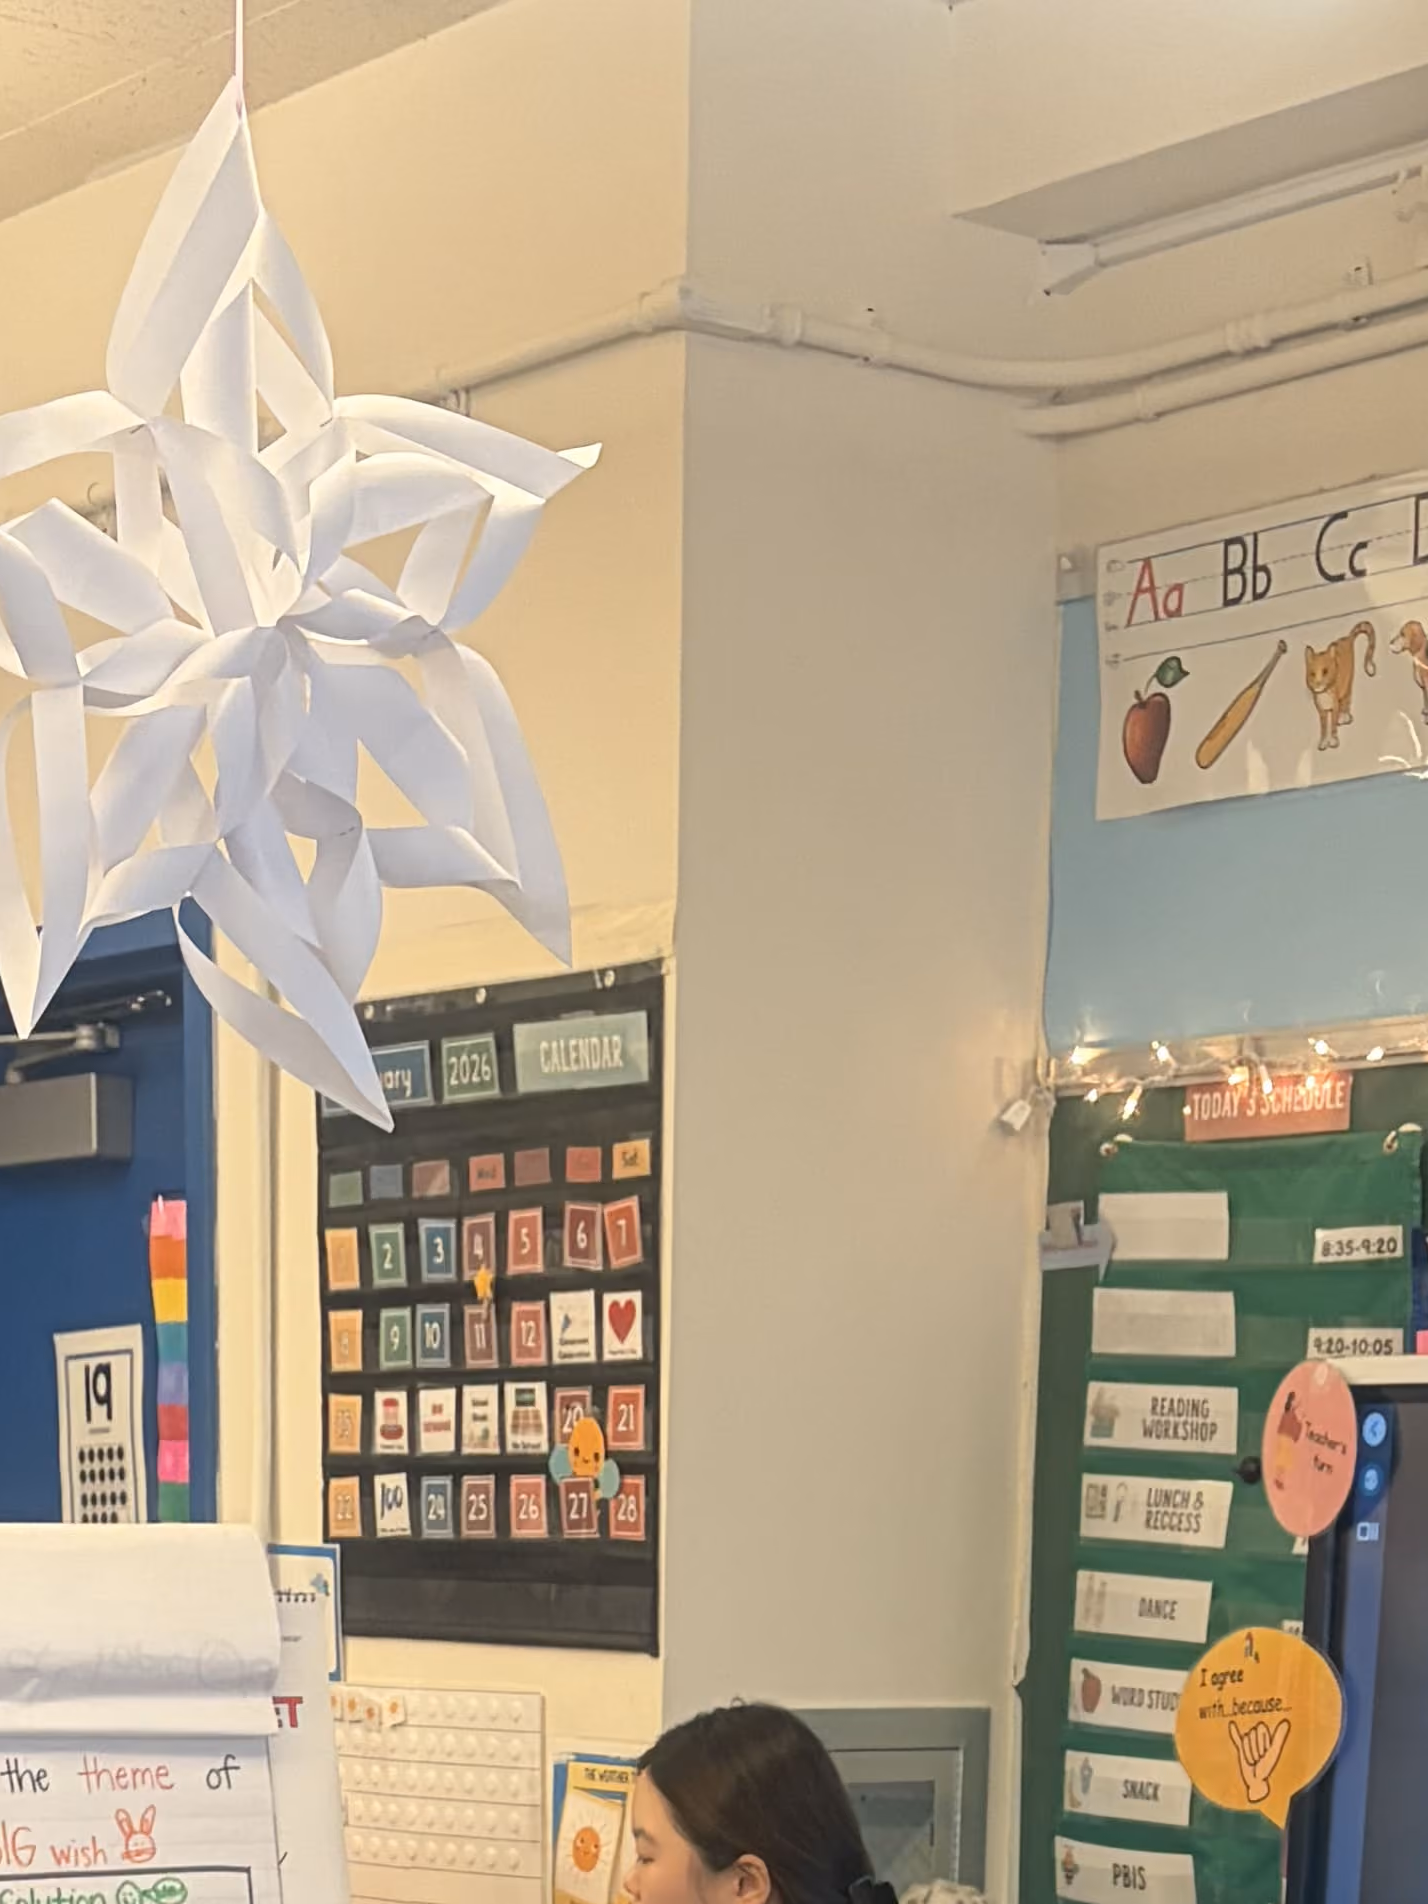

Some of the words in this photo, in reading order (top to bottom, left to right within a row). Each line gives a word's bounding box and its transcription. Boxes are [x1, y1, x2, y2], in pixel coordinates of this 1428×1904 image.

[1127, 557, 1185, 628] Aa
[1221, 534, 1274, 608] Bb
[1314, 509, 1368, 584] Cc
[449, 1054, 491, 1085] 2026
[539, 1035, 623, 1072] CALENDAR
[382, 1244, 392, 1269] 2
[433, 1238, 444, 1264] 3
[474, 1234, 484, 1259] 4
[522, 1229, 530, 1253] 5
[577, 1221, 586, 1248] 6
[617, 1220, 626, 1246] 7
[1322, 1238, 1397, 1256] 8:35-9:20
[390, 1326, 399, 1350] 9
[425, 1323, 441, 1348] 10
[475, 1324, 486, 1347] 11
[522, 1321, 536, 1346] 12
[83, 1361, 113, 1424] 19
[618, 1404, 635, 1431] 21
[1151, 1396, 1210, 1419] READING
[1142, 1419, 1217, 1441] WORKSHOP
[428, 1495, 445, 1519] 24
[469, 1494, 487, 1520] 25
[519, 1494, 539, 1518] 26
[569, 1494, 588, 1519] 27
[617, 1495, 637, 1521] 28
[1146, 1488, 1189, 1510] LUNCH
[1138, 1598, 1177, 1620] DANCE
[1200, 1668, 1207, 1687] I
[1211, 1668, 1244, 1690] agree
[1112, 1686, 1143, 1707] WORD
[0, 1758, 50, 1793] the
[78, 1756, 175, 1793] theme
[206, 1754, 240, 1790] of
[1122, 1779, 1160, 1801] SNACK
[50, 1836, 107, 1866] wish
[1113, 1863, 1146, 1890] PBIS
